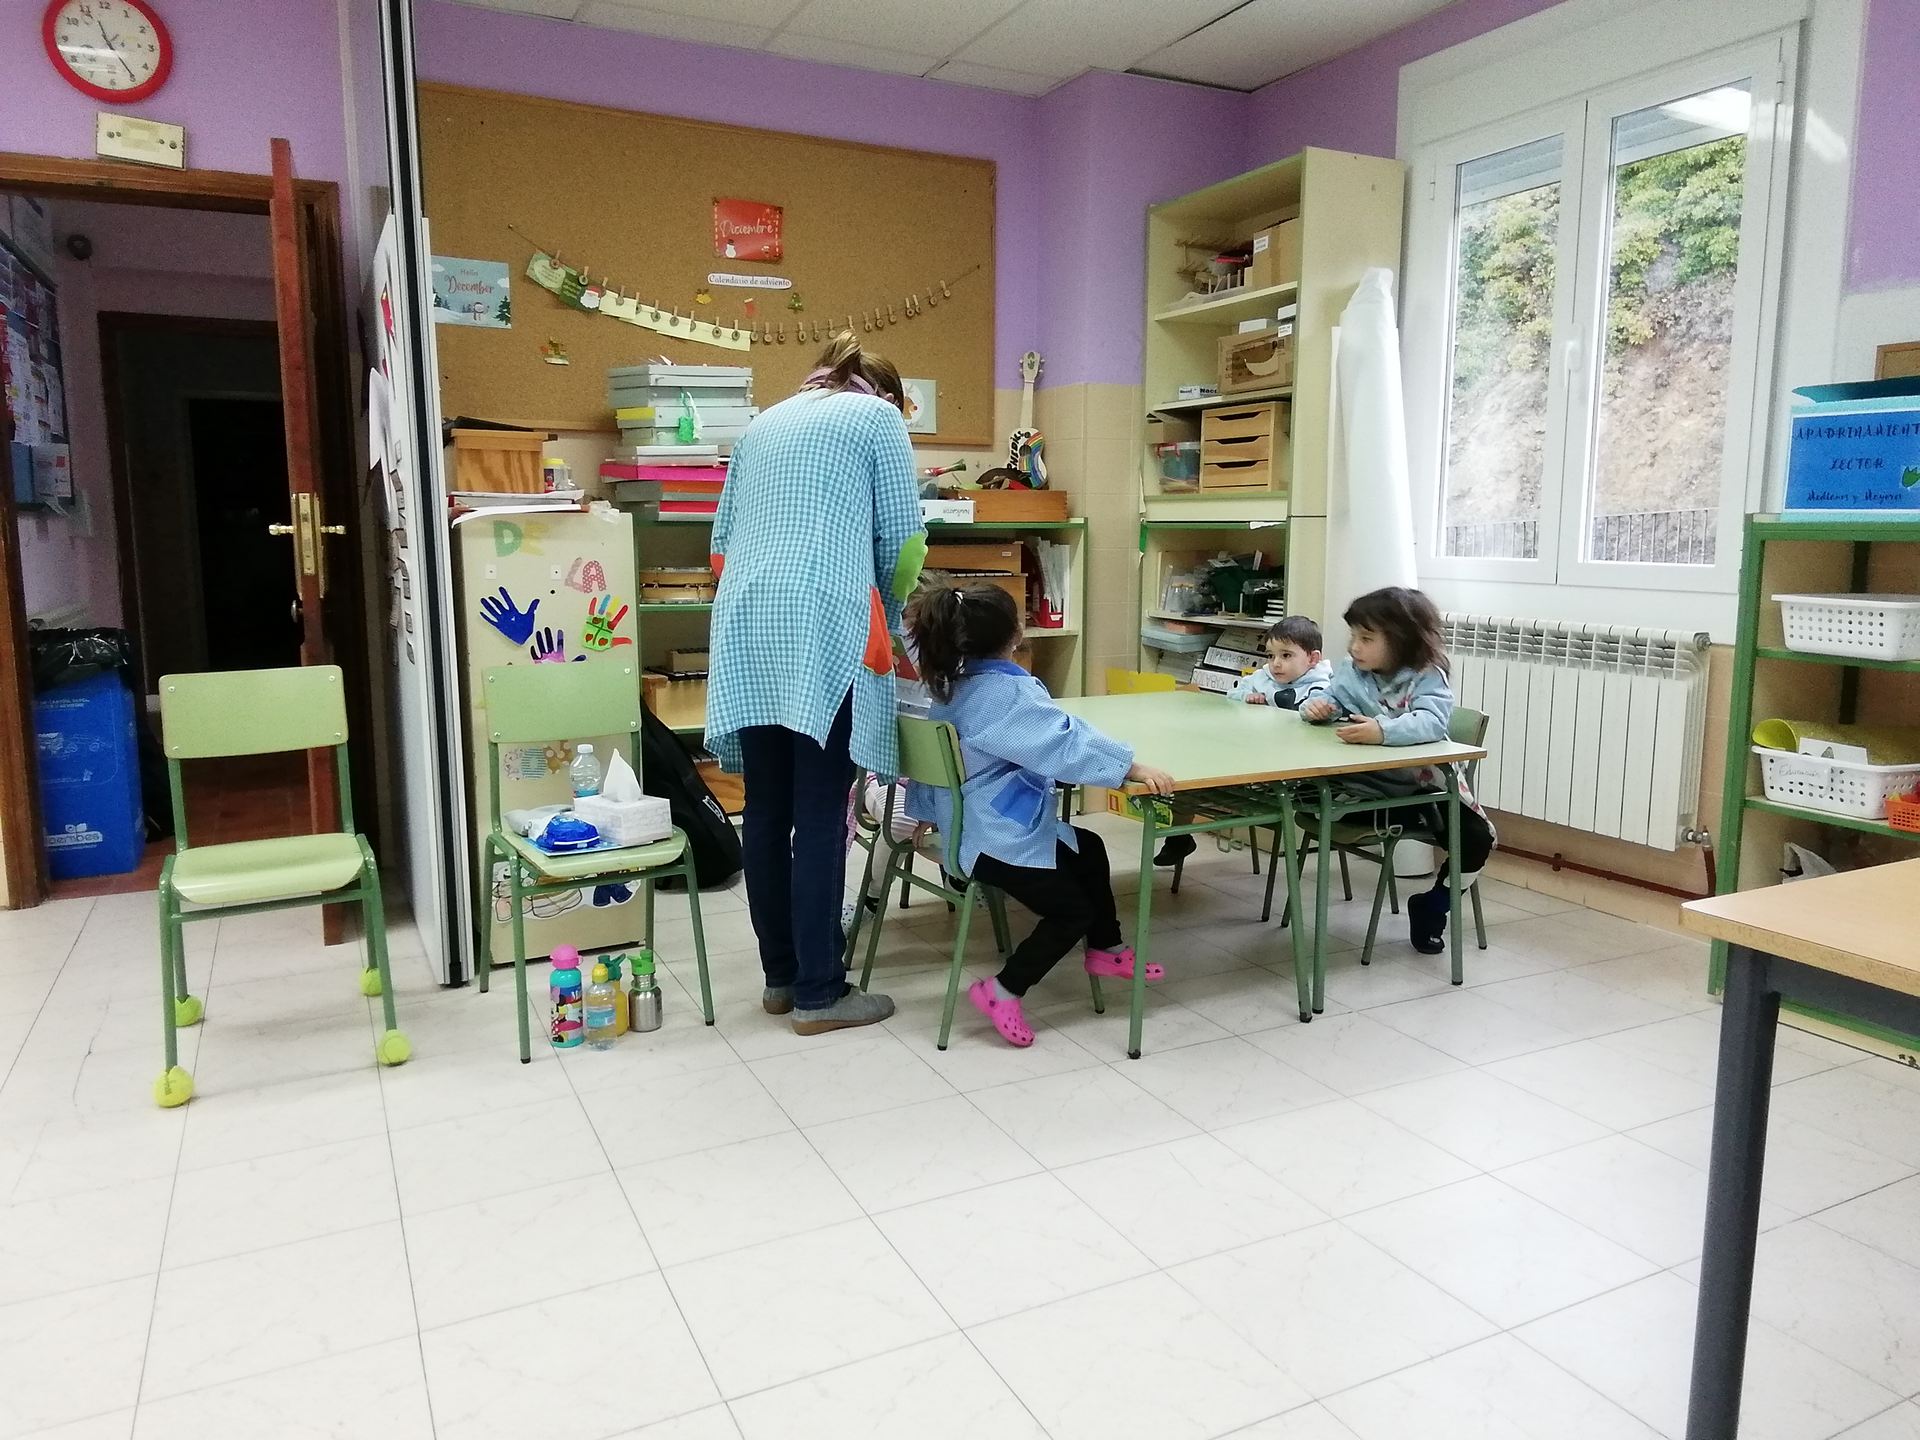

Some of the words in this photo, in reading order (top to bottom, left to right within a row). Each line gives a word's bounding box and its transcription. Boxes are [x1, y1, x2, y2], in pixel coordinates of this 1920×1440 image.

[99, 1, 110, 9] 12
[80, 5, 91, 17] 11
[123, 9, 130, 18] 1
[139, 26, 146, 34] 2
[61, 35, 69, 43] 9
[147, 44, 155, 52] 3
[142, 62, 149, 70] 4
[720, 217, 774, 238] Diciembre
[445, 274, 495, 295] December
[710, 274, 749, 285] Calendario
[750, 276, 758, 285] de
[760, 277, 790, 287] adviento
[1830, 457, 1886, 470] LECTOR
[564, 556, 607, 594] LA
